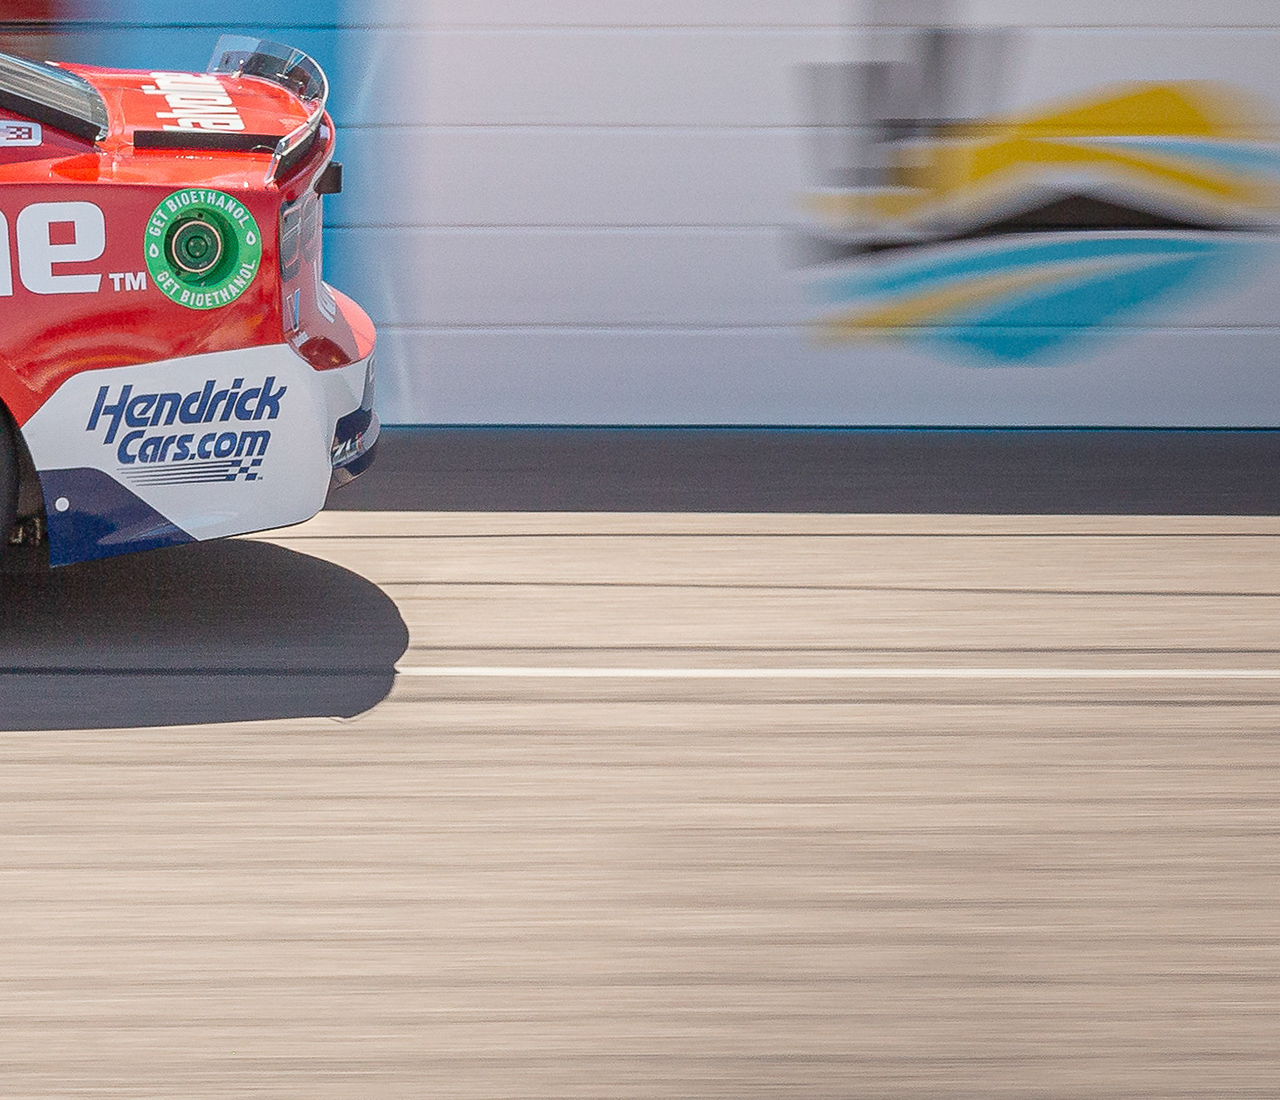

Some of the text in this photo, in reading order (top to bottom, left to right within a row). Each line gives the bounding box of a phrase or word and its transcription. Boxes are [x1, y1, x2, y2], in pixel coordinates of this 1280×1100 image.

[148, 190, 250, 238] GET BIOETHANOL
[108, 271, 147, 292] TM
[156, 259, 257, 307] GET BIOETHANOL
[85, 375, 288, 446] Hendrick
[116, 429, 272, 465] Cars.com
